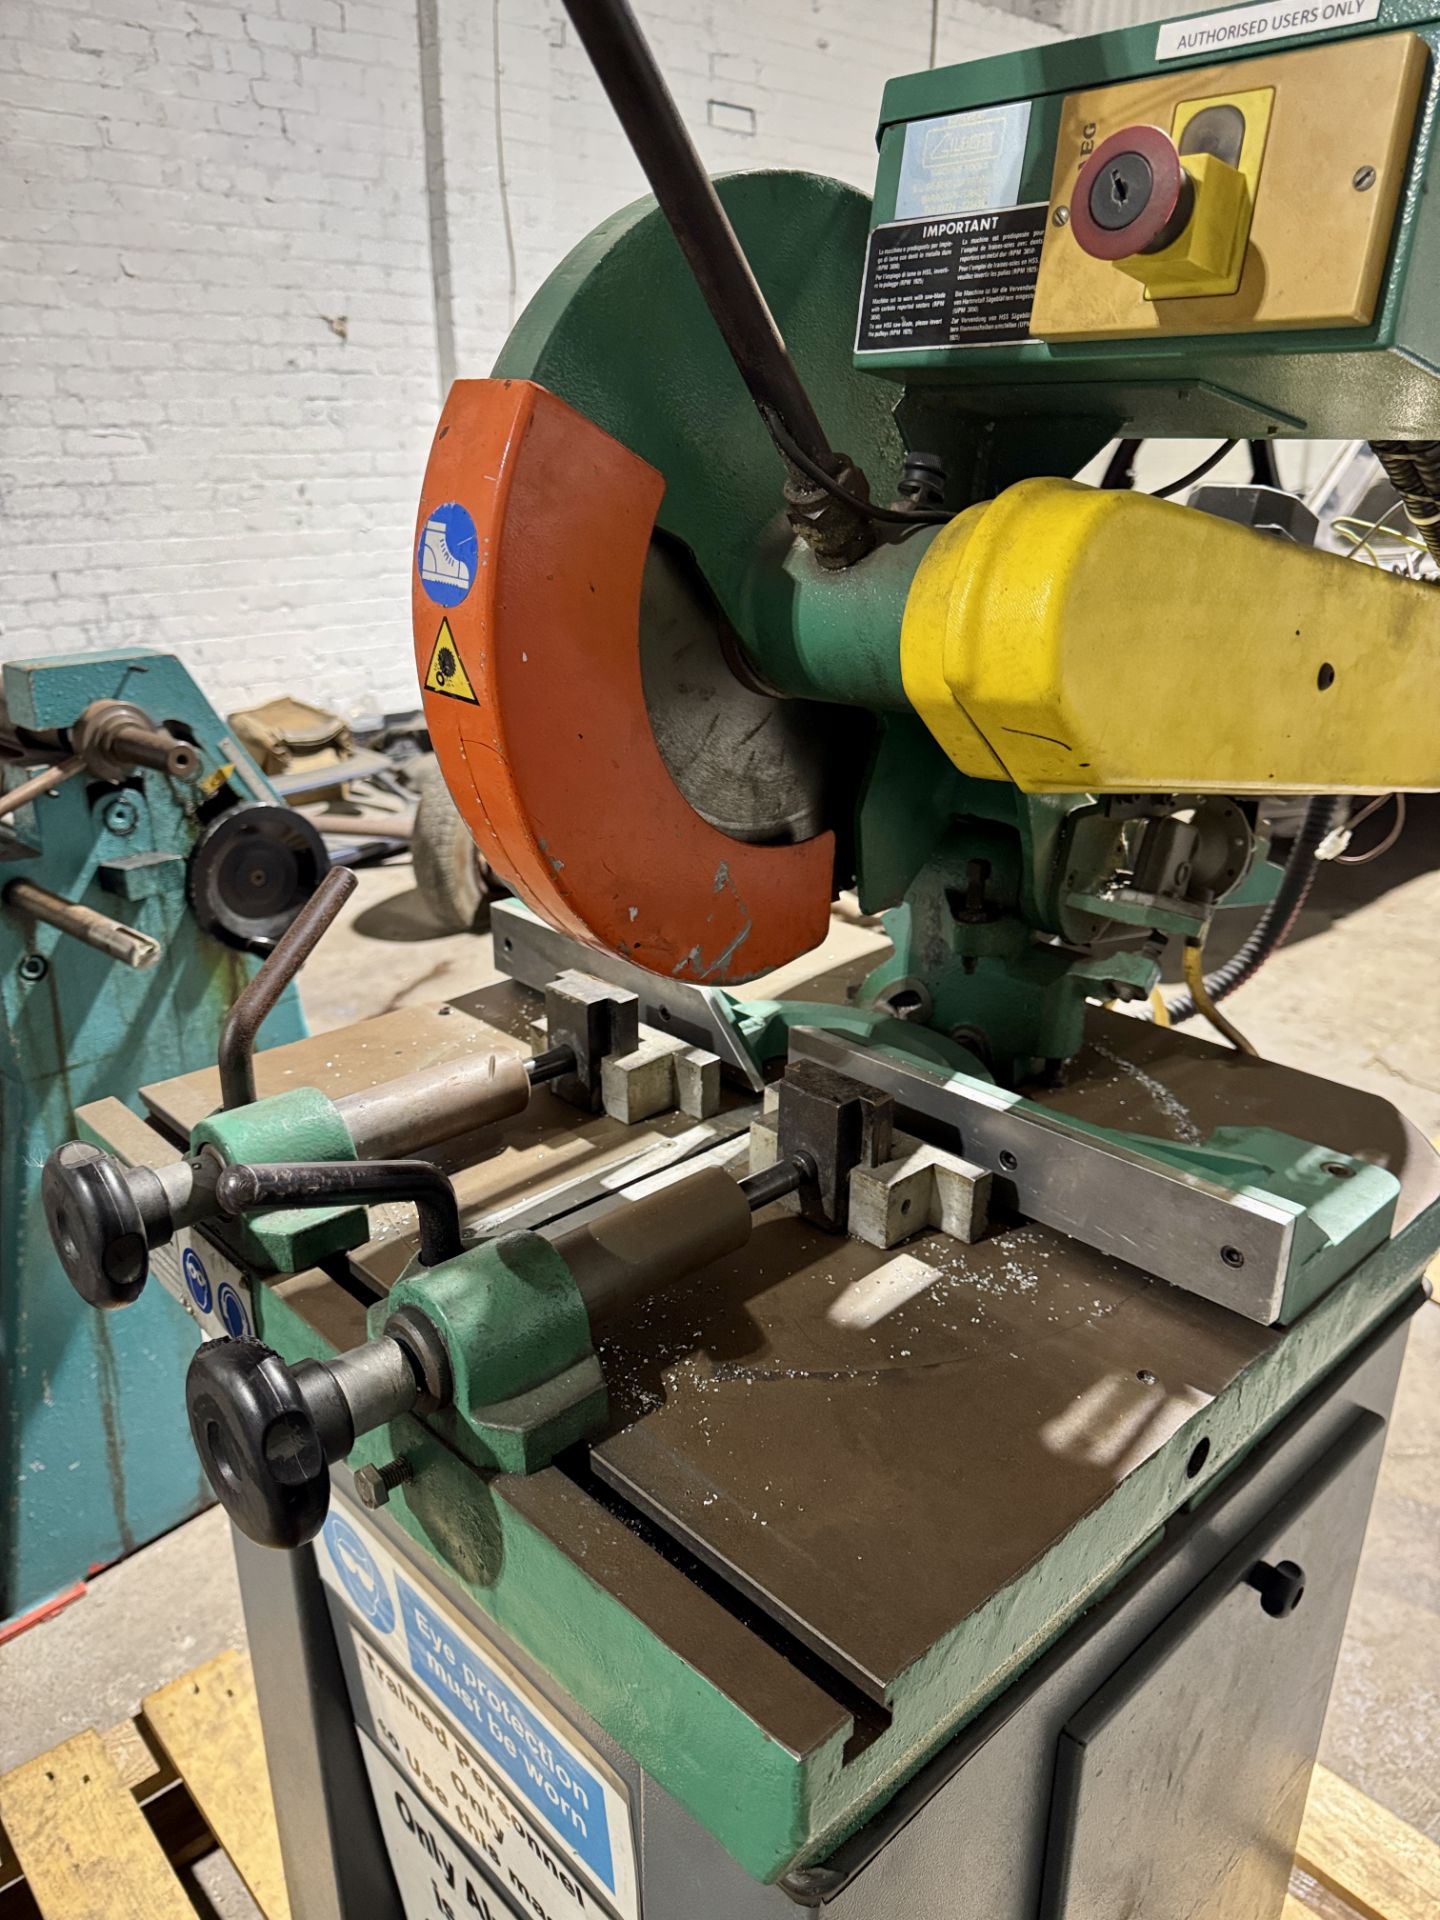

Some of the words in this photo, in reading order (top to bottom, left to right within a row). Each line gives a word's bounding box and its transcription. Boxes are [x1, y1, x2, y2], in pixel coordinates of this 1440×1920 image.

[1177, 18, 1268, 50] AUTHORISED
[1272, 7, 1318, 31] USERS
[1322, 0, 1365, 20] ONLY
[922, 216, 999, 239] IMPORTANT
[414, 1608, 455, 1664] Eye
[463, 1662, 589, 1810] protection
[426, 1651, 483, 1723] must
[487, 1711, 517, 1759] be
[522, 1753, 588, 1839] worn
[362, 1646, 450, 1752] Trained
[455, 1743, 586, 1910] Personnel
[377, 1717, 400, 1752] to
[404, 1747, 449, 1808] Use
[455, 1804, 502, 1867] this
[450, 1770, 504, 1846] Only
[394, 1791, 456, 1890] Only
